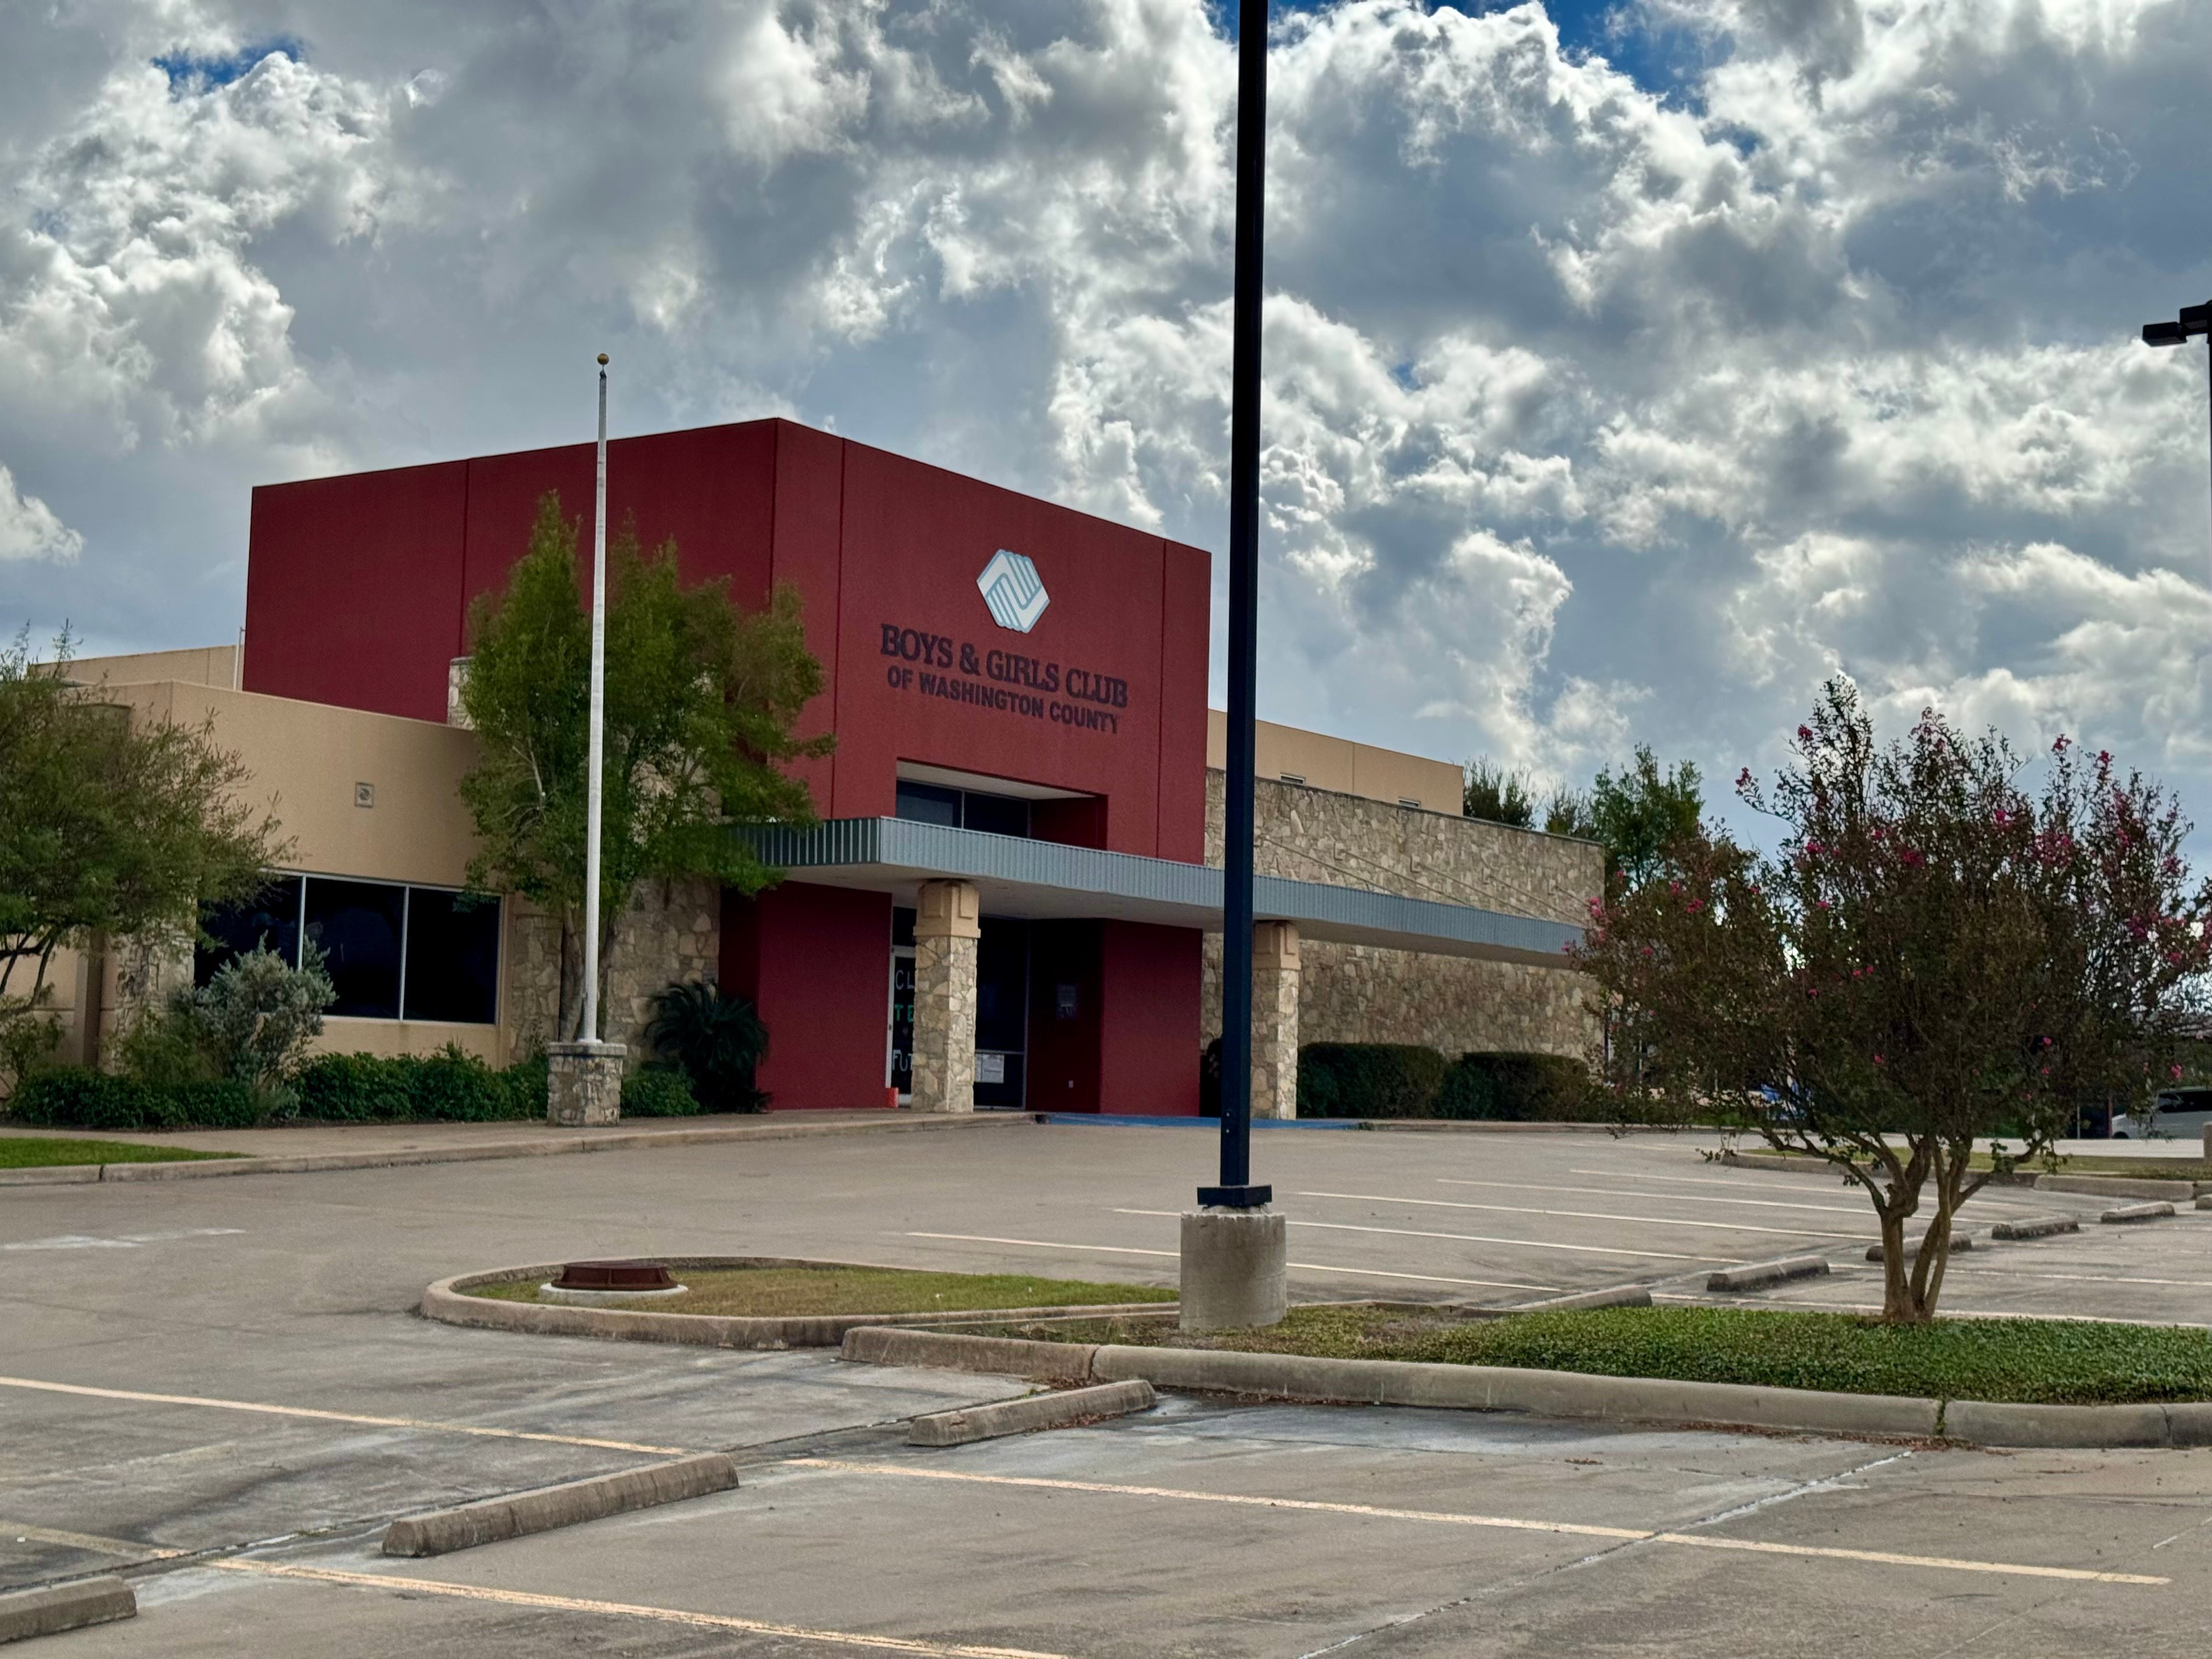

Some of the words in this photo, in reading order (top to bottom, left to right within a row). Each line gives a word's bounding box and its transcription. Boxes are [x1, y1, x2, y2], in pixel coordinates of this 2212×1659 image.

[881, 624, 953, 668] BOYS
[960, 642, 980, 676] &
[986, 650, 1059, 692] GIRLS
[1066, 668, 1127, 708] CLUB
[888, 665, 913, 690] OF
[919, 672, 1044, 719] WASHINGTON
[1049, 701, 1118, 734] COUNTY
